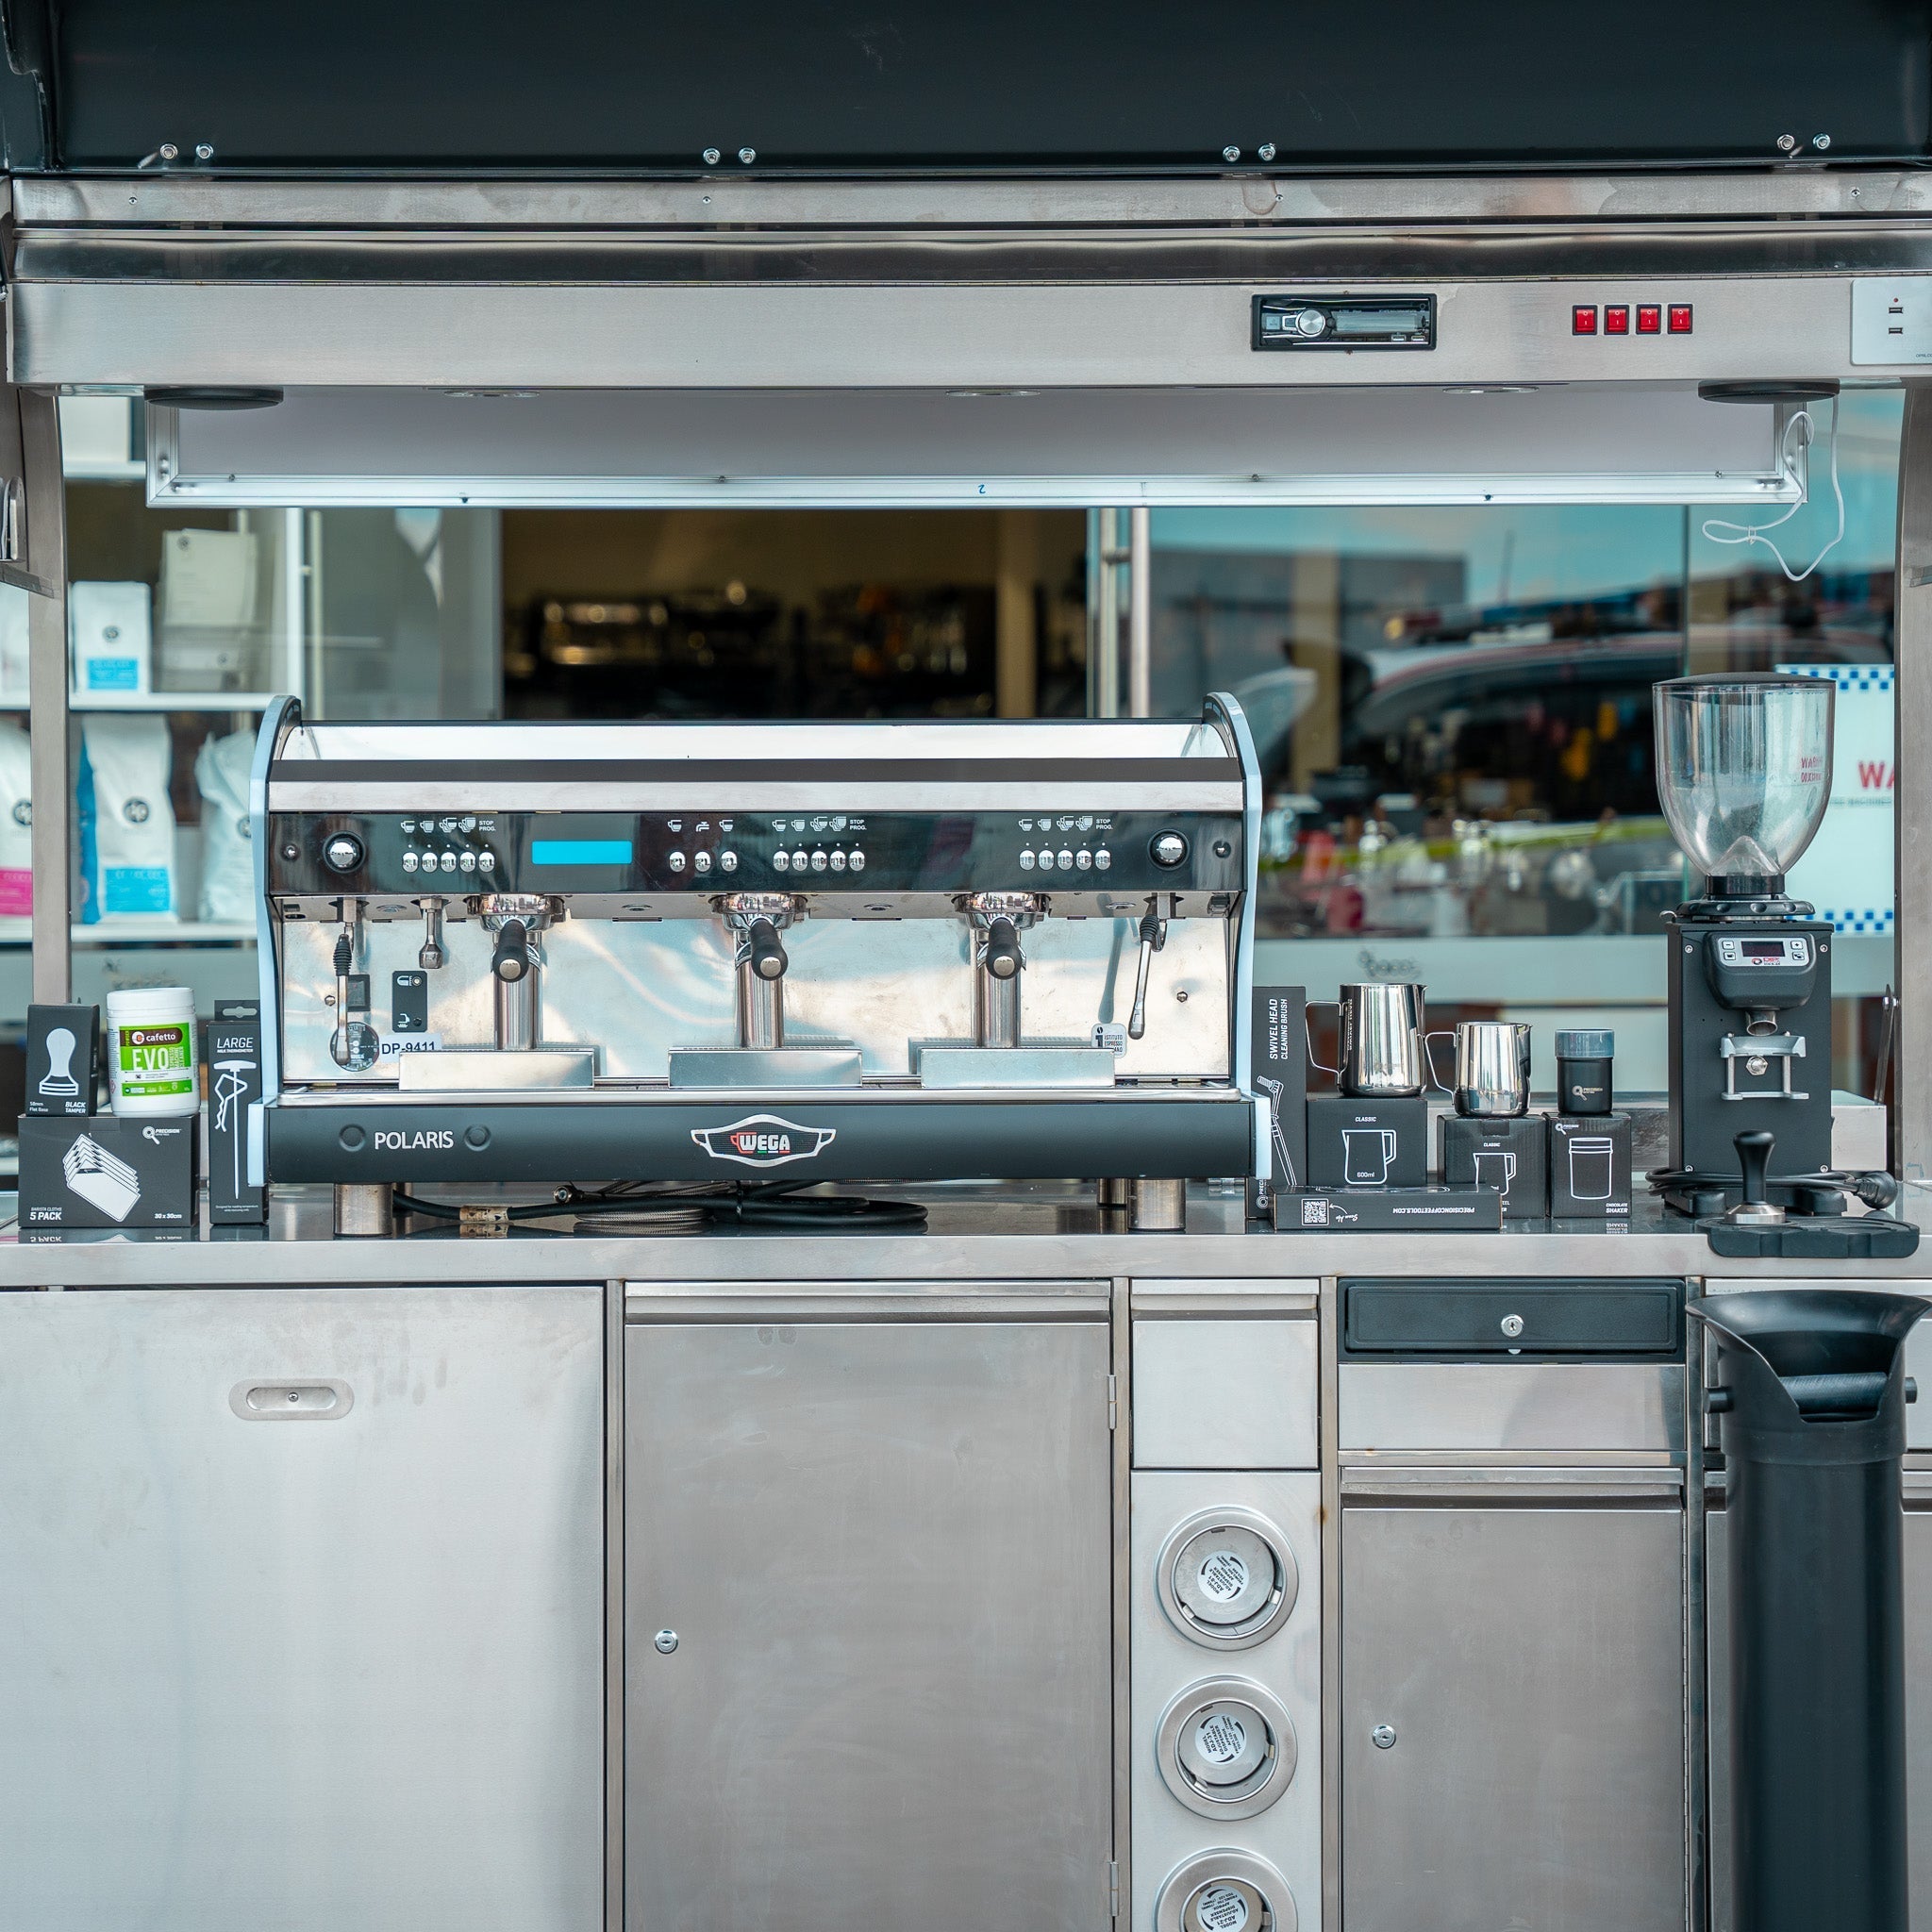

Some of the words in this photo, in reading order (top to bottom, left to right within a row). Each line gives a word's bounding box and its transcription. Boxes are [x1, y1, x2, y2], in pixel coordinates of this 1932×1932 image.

[1269, 998, 1278, 1024] HEAD
[145, 1033, 175, 1041] cafetto
[217, 1037, 254, 1048] LARGE
[1269, 1025, 1278, 1059] SWIVEL
[1280, 1024, 1289, 1059] CLEANING
[381, 1041, 435, 1054] DP-9411
[132, 1047, 169, 1071] EVO
[375, 1131, 455, 1150] POLARIS
[739, 1134, 791, 1151] WEGA
[29, 1211, 36, 1221] 5
[38, 1211, 62, 1221] PACK
